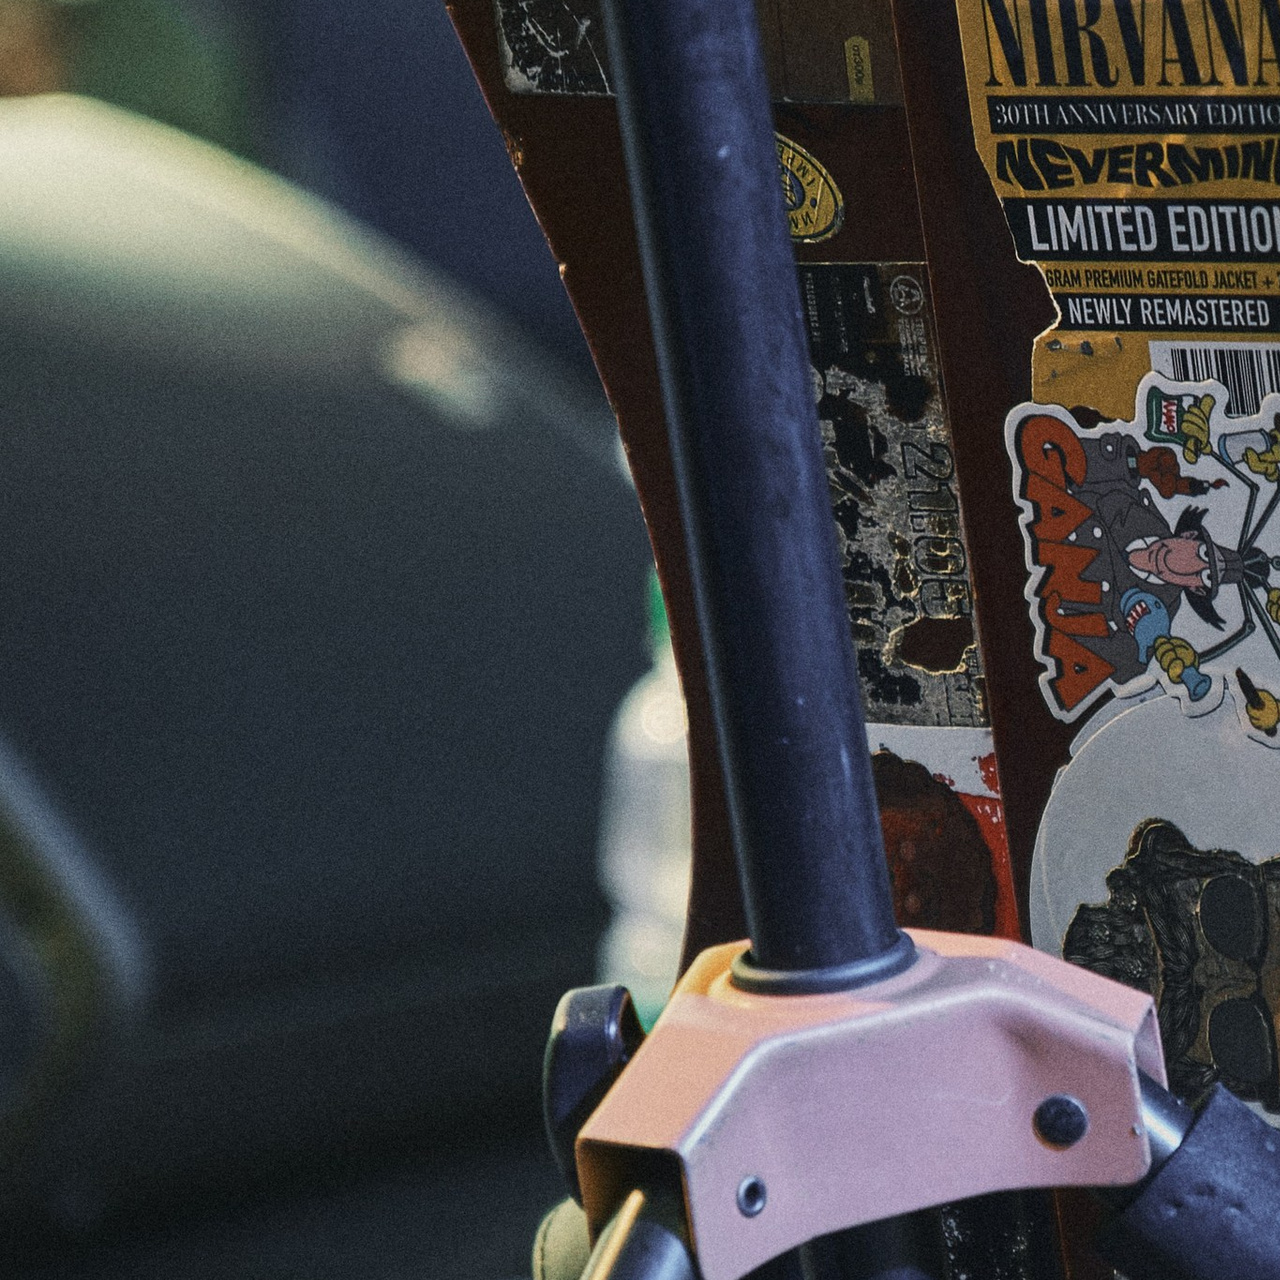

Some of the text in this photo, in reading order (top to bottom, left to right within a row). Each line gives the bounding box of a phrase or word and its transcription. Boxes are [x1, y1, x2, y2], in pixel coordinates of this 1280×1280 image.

[996, 103, 1050, 126] 30TH
[1056, 102, 1201, 127] ANNIVERSARY
[1027, 204, 1158, 252] LIMITED
[1046, 269, 1082, 289] GRAM
[1085, 269, 1144, 289] PREMIUM
[1147, 269, 1210, 290] GATEFOLD
[1213, 270, 1258, 290] JACKET
[1068, 298, 1271, 327] NEWLY REMASTERED
